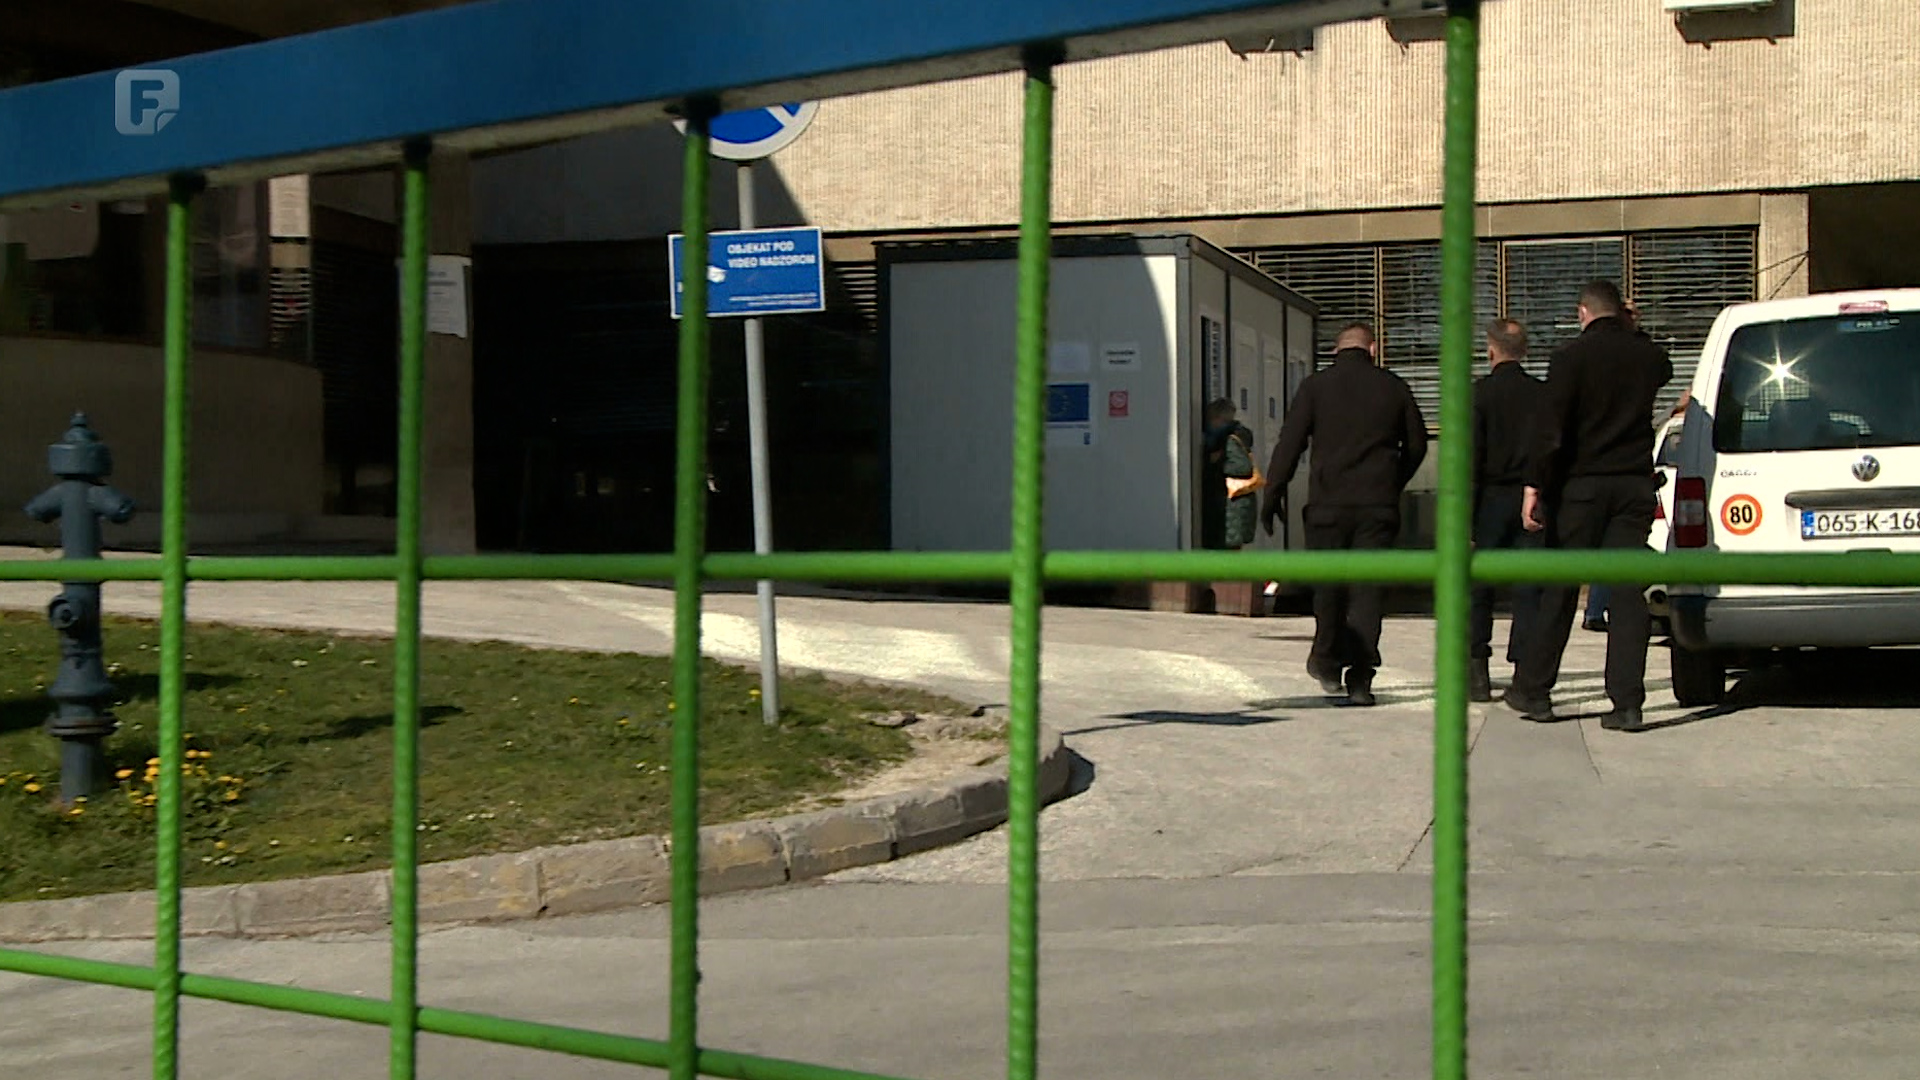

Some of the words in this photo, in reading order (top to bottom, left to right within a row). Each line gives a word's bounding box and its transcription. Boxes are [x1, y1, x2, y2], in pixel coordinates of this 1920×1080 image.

[727, 242, 771, 255] OBJEKAT
[773, 240, 795, 252] POD
[728, 256, 758, 268] VIDEO
[760, 254, 816, 267] NADZOROM
[1729, 504, 1753, 525] 80
